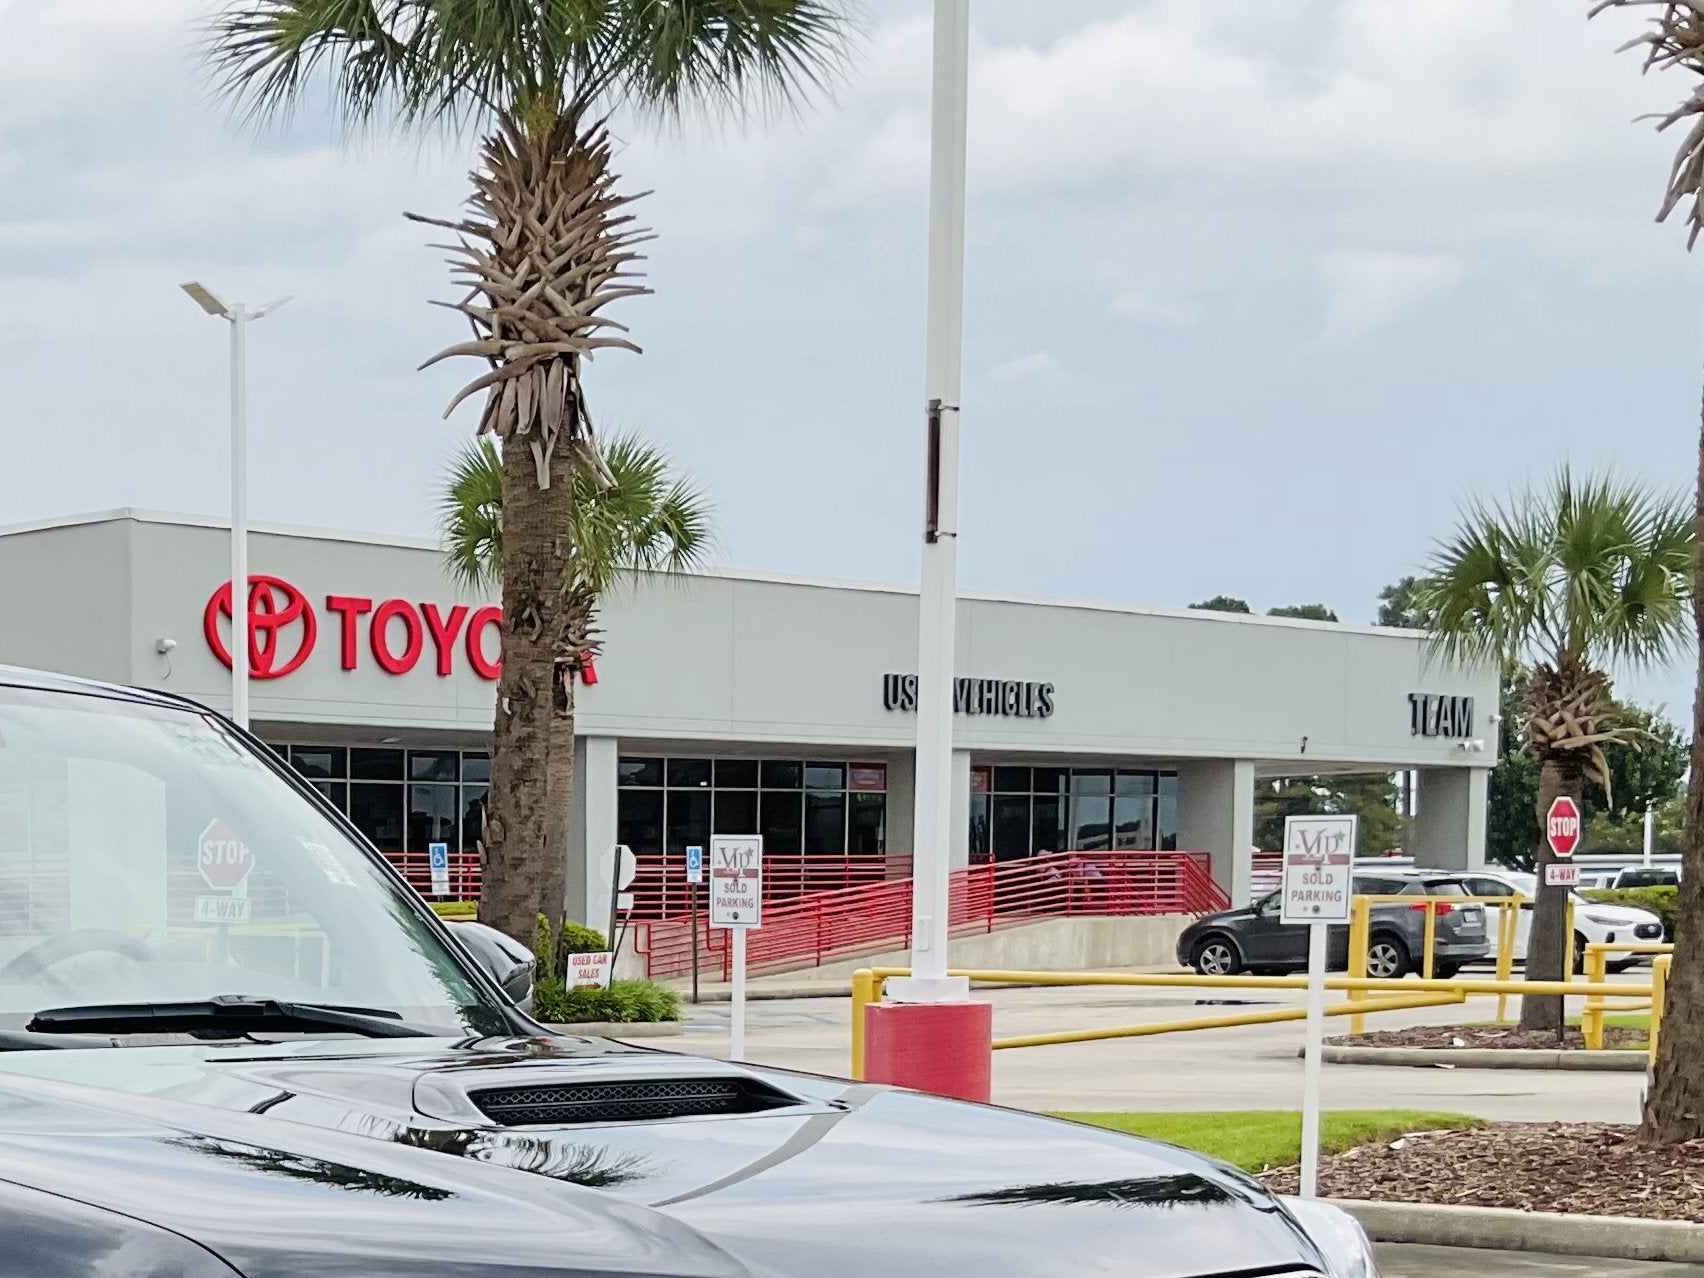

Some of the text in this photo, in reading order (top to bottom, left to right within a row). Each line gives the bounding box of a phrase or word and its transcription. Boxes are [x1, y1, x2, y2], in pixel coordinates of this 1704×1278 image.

[953, 677, 1055, 718] VEHICLES
[1408, 693, 1474, 738] TEAM
[1550, 816, 1577, 837] STOP
[202, 840, 250, 865] STOP
[1302, 873, 1334, 885] SOLD
[1550, 868, 1576, 881] 4-WAY
[723, 883, 748, 894] SOLD
[1290, 890, 1342, 902] PARKING
[200, 900, 245, 918] 4-WAY
[716, 897, 754, 909] PARKING
[572, 954, 608, 966] USED CAR
[578, 968, 600, 979] SALES
